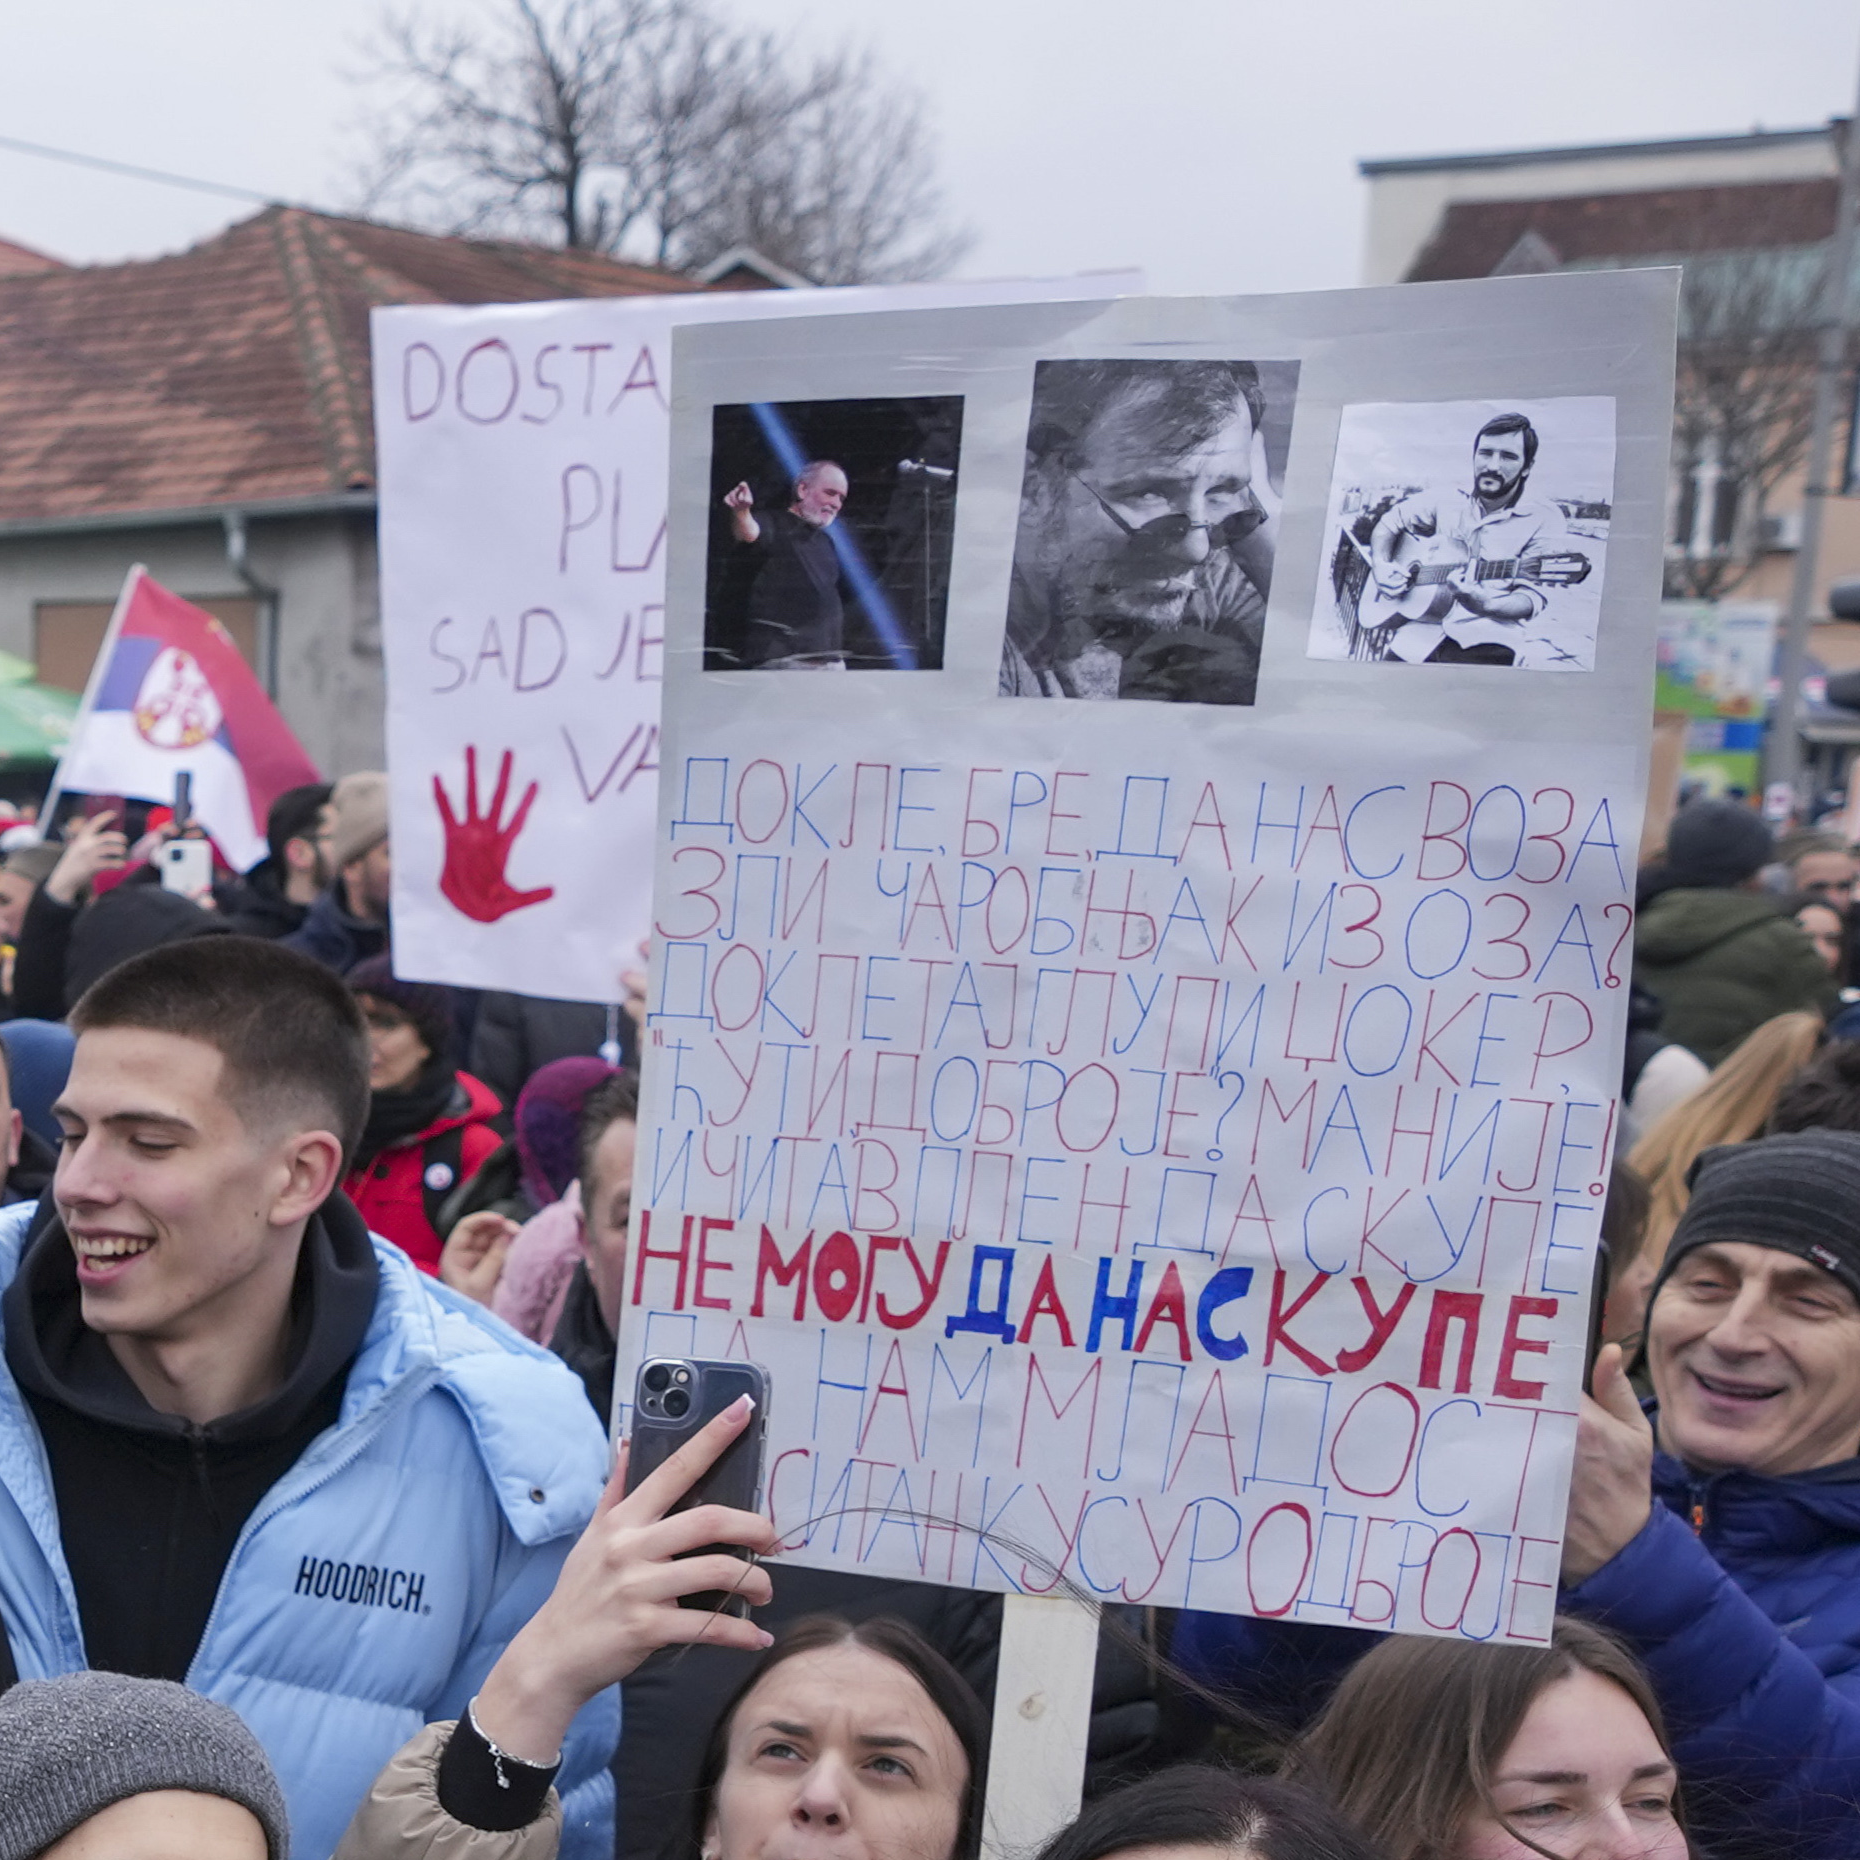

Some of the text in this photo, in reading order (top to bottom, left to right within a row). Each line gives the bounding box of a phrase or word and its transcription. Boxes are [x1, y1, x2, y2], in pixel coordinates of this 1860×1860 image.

[559, 463, 667, 574] PL
[428, 607, 568, 696] SAD
[1094, 775, 1232, 871] ДА
[1251, 781, 1406, 880] НАС
[1416, 780, 1628, 893] ВОЗА
[655, 846, 1633, 990] ЗЛИ ЧАРОБЊАК ИЗ ОЗА?
[646, 941, 900, 1040] ДОКЛЕ
[908, 958, 1019, 1051] ТАЈ
[1028, 968, 1265, 1068] ГЛУПИ
[855, 1050, 1120, 1153] ДОБРО
[1251, 1077, 1374, 1176] МА
[1385, 1084, 1616, 1197] НИЈЕ!
[651, 1127, 1594, 1295] И ЧИТАВ ПЛЕН ДА СКУПЕ
[630, 1209, 1559, 1400] НЕ МОГУ ДА НАС КУПЕ
[812, 1327, 1579, 1533] НАМ МЛАДОСТ
[768, 1448, 964, 1585] СИТАН
[971, 1476, 1243, 1610] КУСУР
